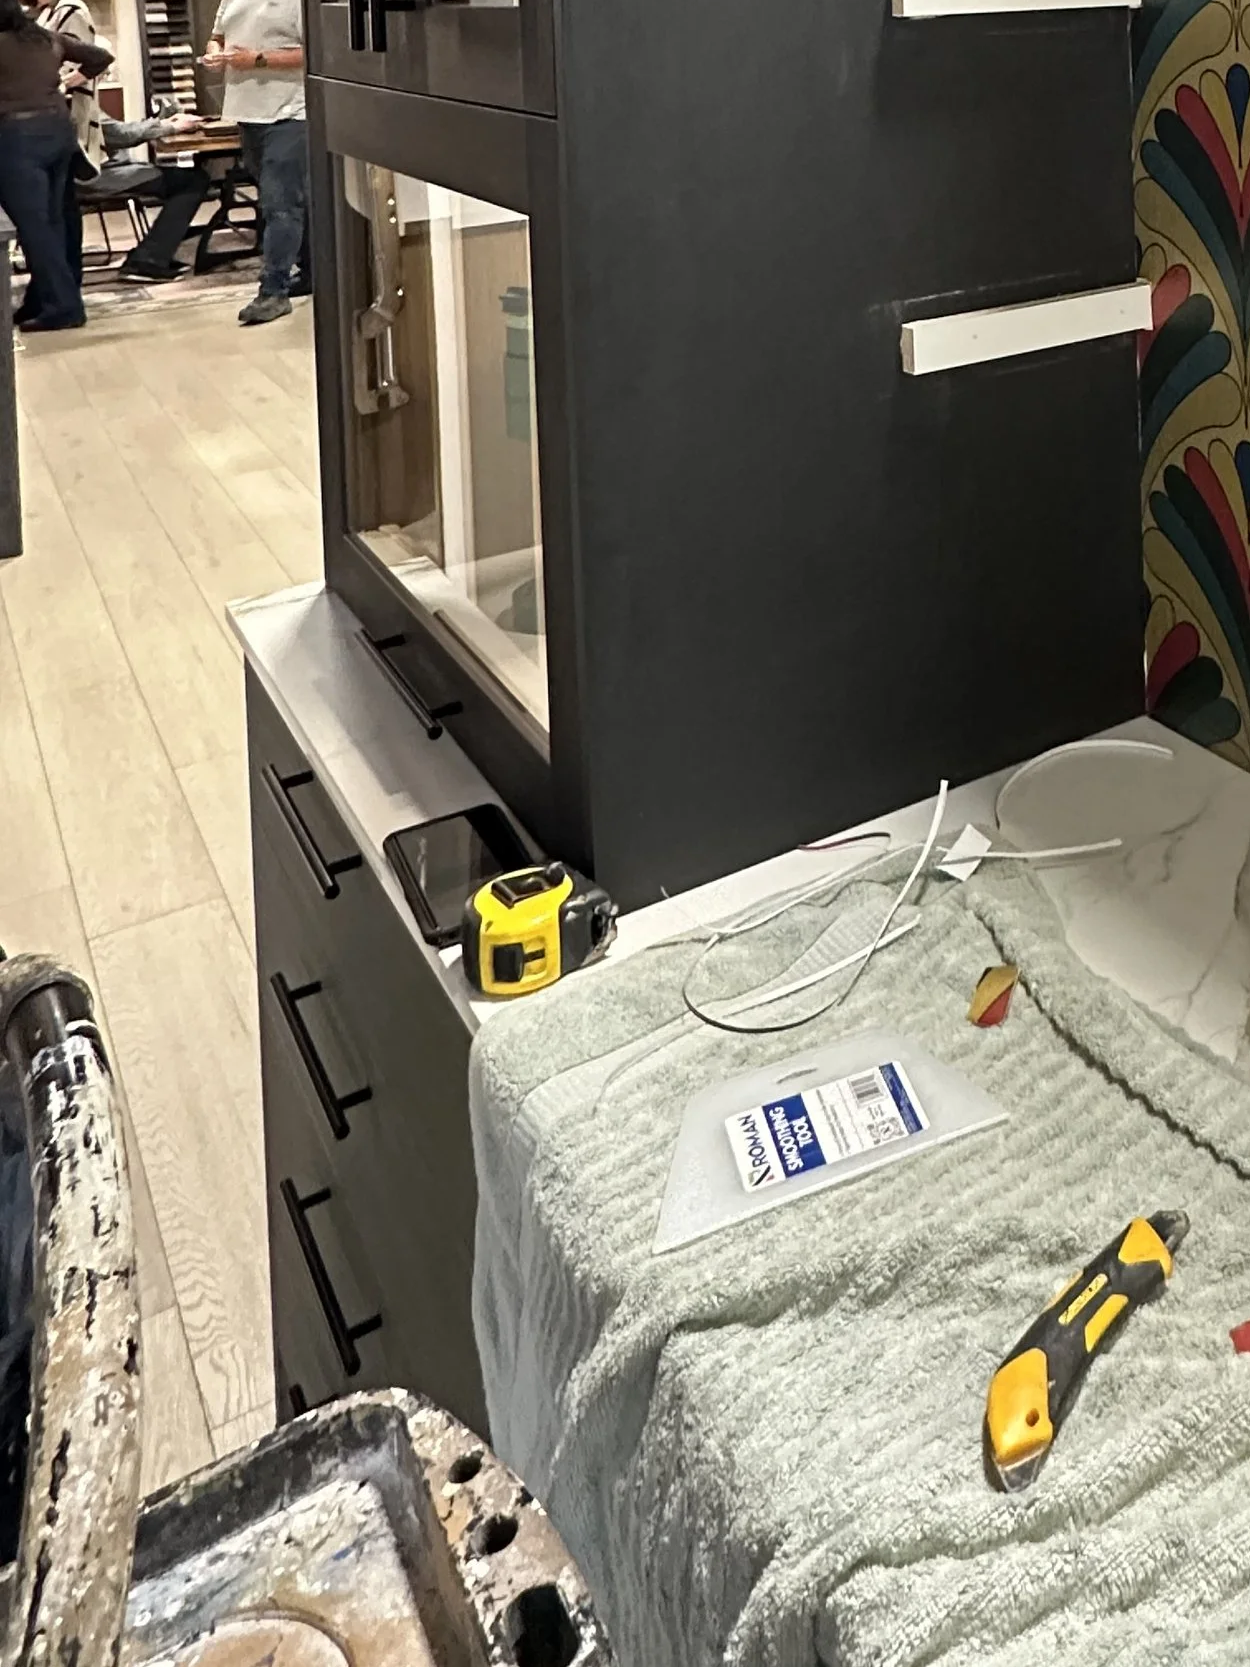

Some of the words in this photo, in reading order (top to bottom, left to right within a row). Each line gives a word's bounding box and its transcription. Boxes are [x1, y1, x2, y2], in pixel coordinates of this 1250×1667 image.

[737, 1113, 768, 1168] ROMAN
[768, 1106, 804, 1171] SMOOTHING
[792, 1115, 814, 1148] TOOL
